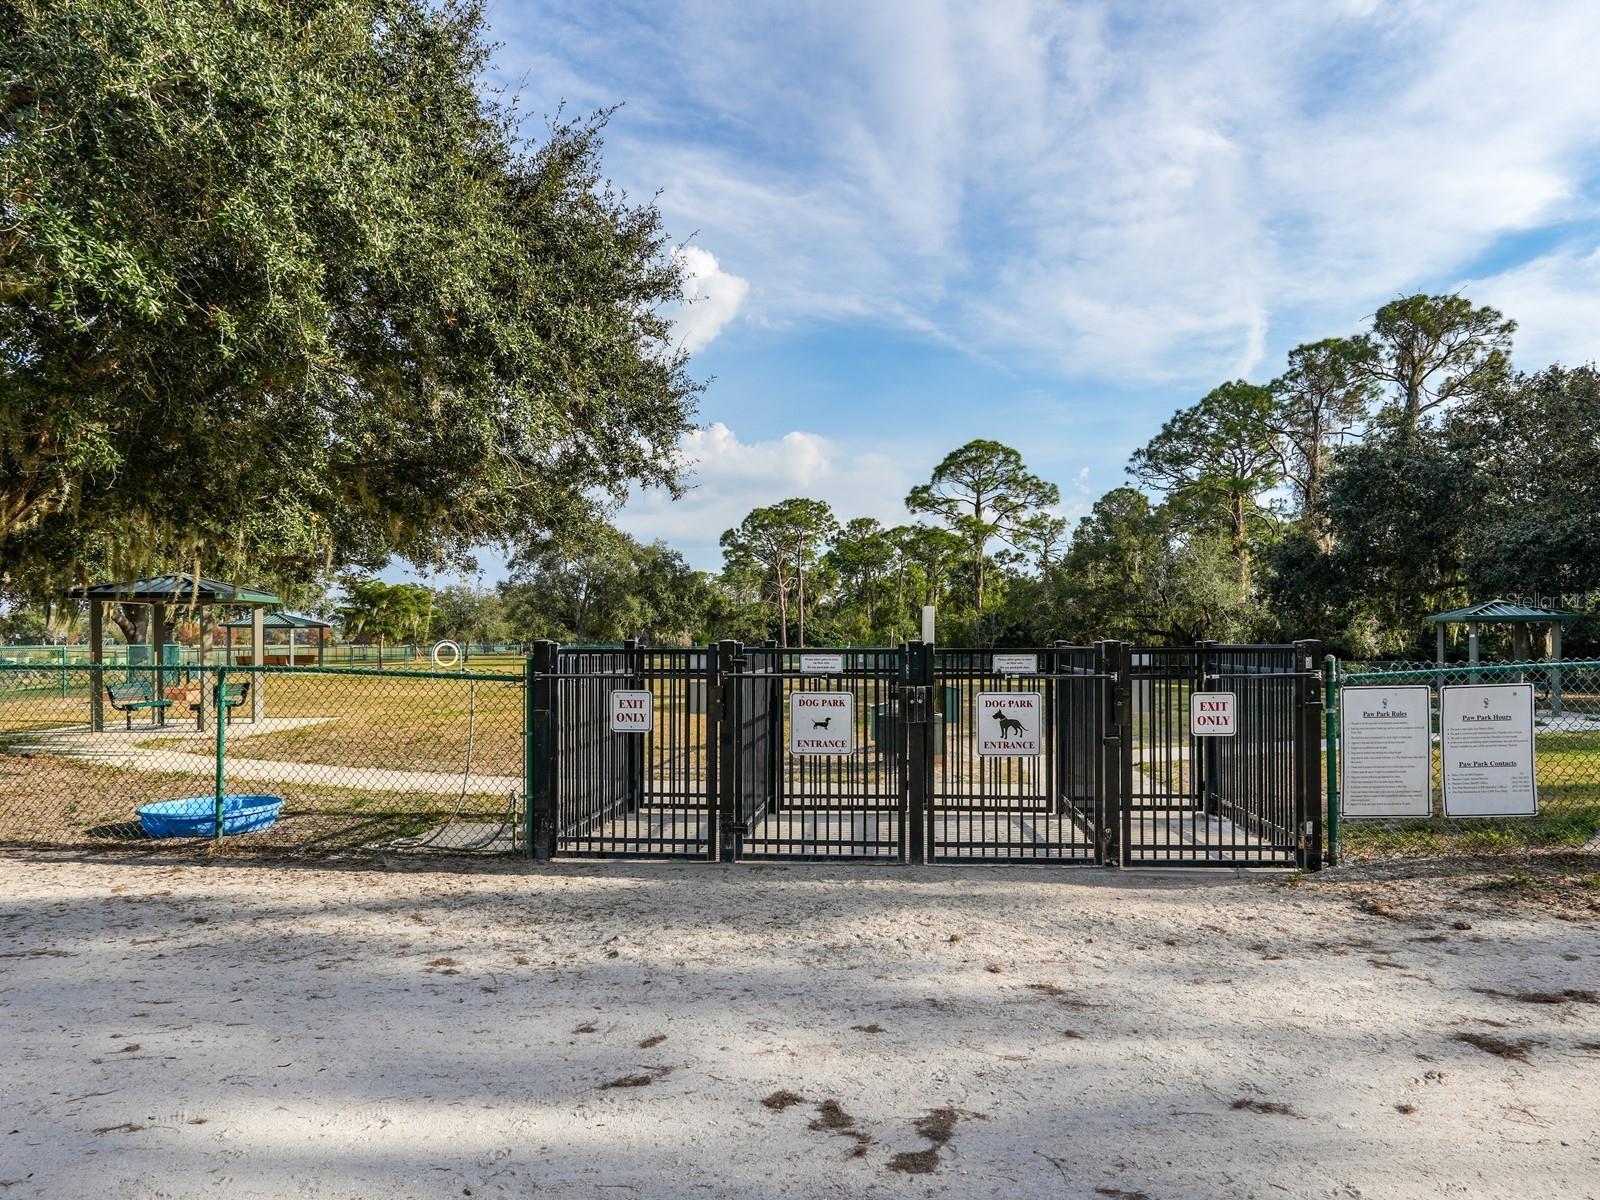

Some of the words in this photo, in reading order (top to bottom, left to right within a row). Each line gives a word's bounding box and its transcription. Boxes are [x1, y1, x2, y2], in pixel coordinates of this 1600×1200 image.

[619, 699, 646, 709] EXIT
[798, 699, 819, 708] DOG
[821, 699, 846, 708] PARK
[985, 700, 1006, 708] DOG
[1008, 700, 1033, 708] PARK
[1200, 701, 1229, 712] EXIT
[616, 712, 647, 723] ONLY
[1391, 710, 1408, 718] Rules
[1493, 713, 1512, 721] Hours
[1197, 715, 1231, 726] ONLY
[797, 739, 848, 748] ENTRANCE
[984, 741, 1036, 750] ENTRANCE
[1473, 760, 1489, 768] Park
[1489, 760, 1517, 768] Contacts
